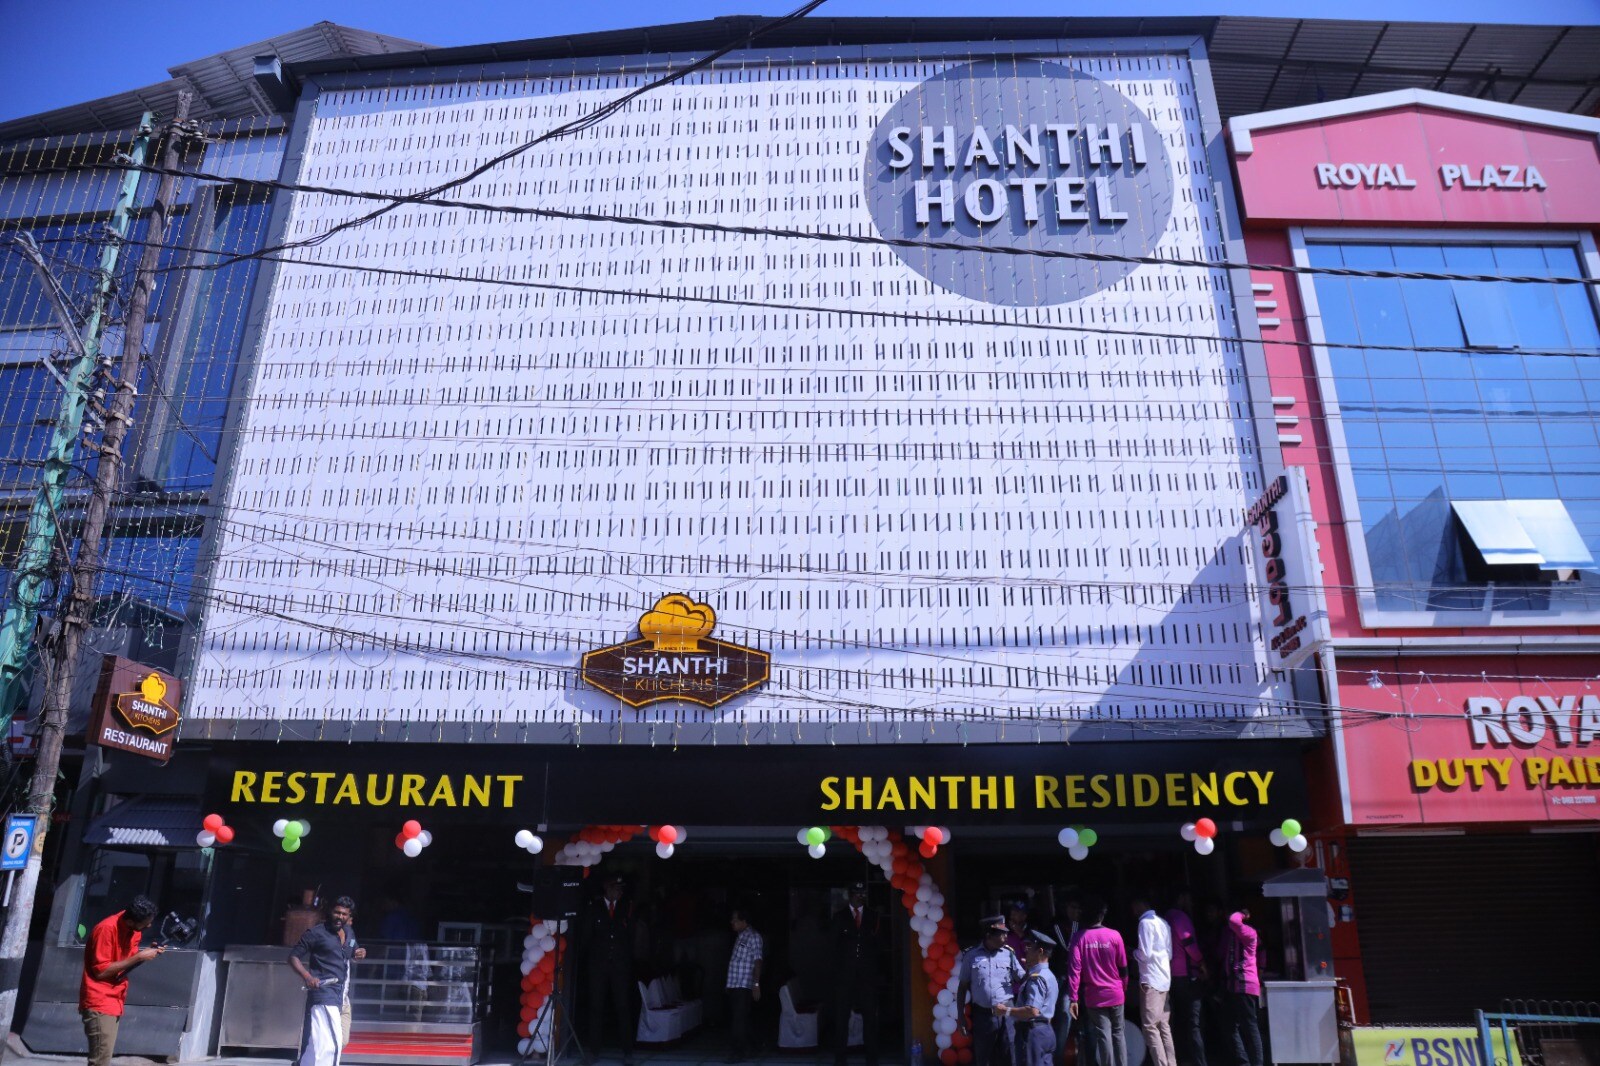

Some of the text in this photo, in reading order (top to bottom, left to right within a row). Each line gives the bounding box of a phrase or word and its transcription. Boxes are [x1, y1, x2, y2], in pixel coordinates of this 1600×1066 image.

[888, 122, 1147, 168] SHANTHI
[1315, 162, 1548, 190] ROYAL PLAZA
[913, 176, 1129, 224] HOTEL
[1247, 475, 1288, 525] SHANTHI
[1259, 510, 1293, 627] LODGE
[623, 656, 729, 675] SHANTHI
[132, 700, 167, 719] SHANTHI
[103, 727, 168, 755] RESTAURANT
[231, 770, 523, 808] RESTAURANT
[820, 771, 1275, 811] SHANTHI RESIDENCY
[1410, 756, 1513, 788] DUTY
